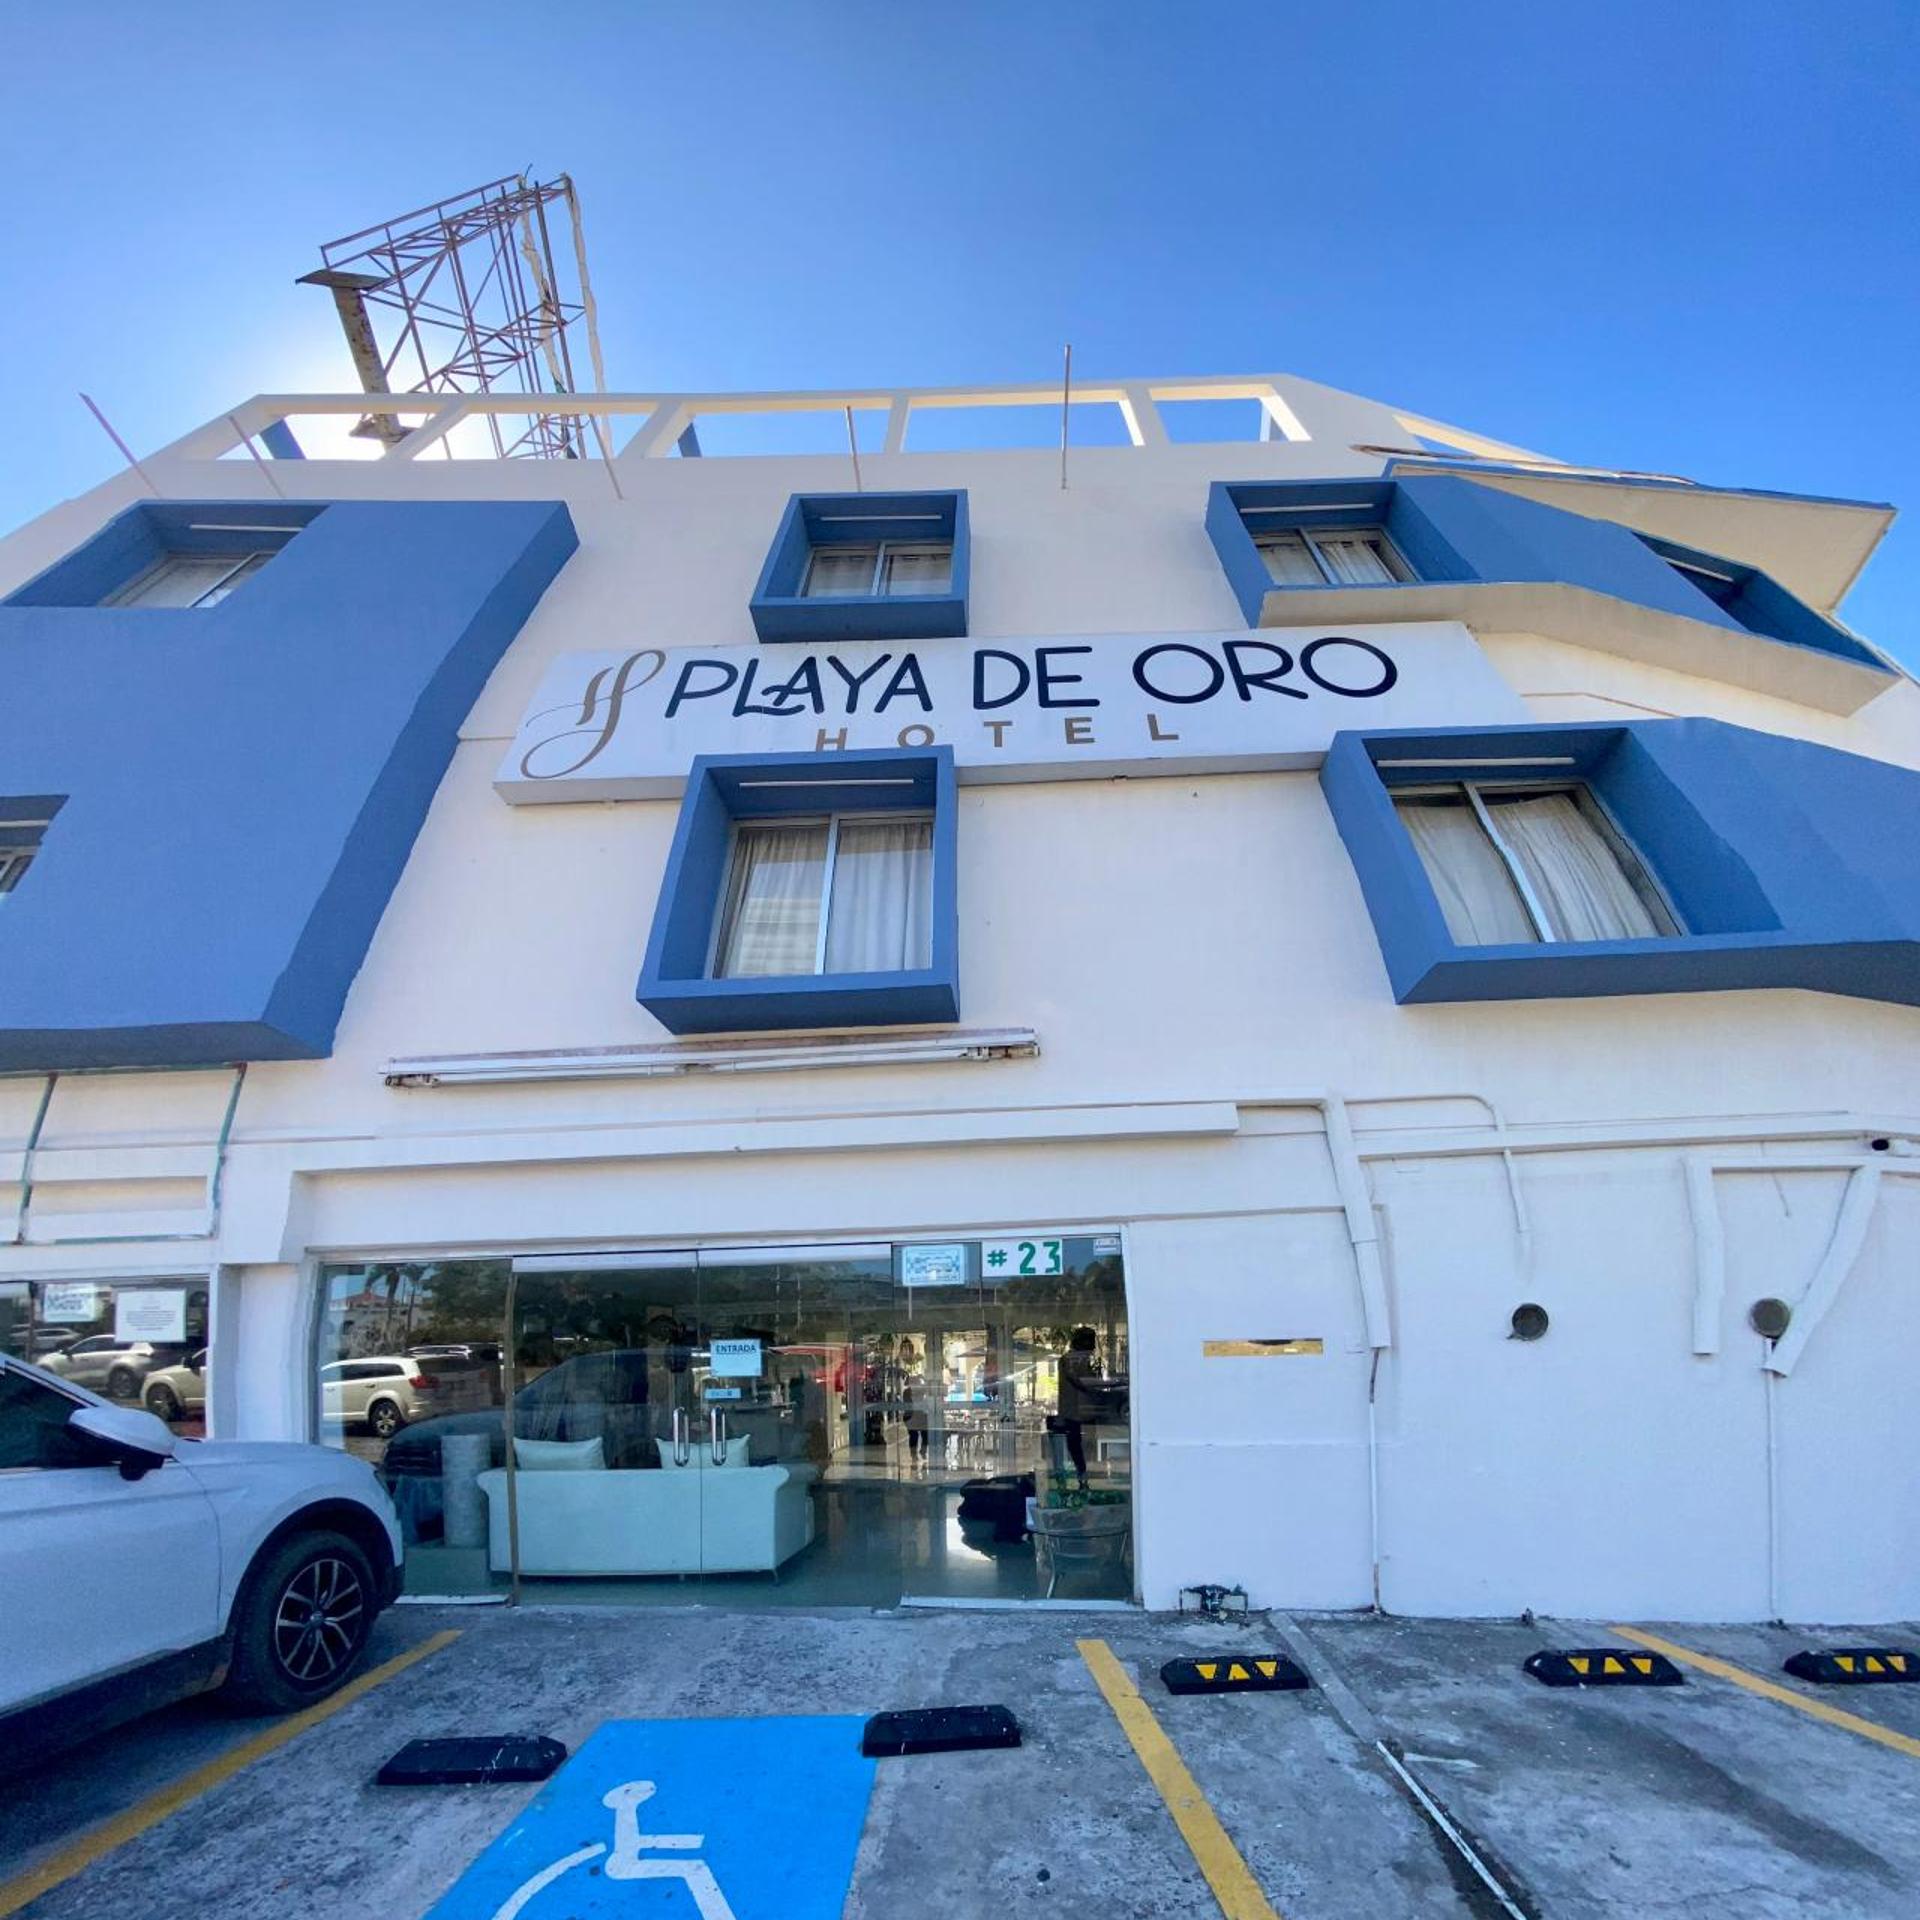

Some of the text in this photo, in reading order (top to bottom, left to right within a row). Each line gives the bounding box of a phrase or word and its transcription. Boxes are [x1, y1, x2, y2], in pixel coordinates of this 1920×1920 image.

[665, 653, 934, 718] PLAYA
[973, 646, 1100, 710] DE
[1132, 637, 1398, 704] ORO
[815, 713, 1179, 751] HOTEL
[716, 1344, 757, 1353] ENTRADA
